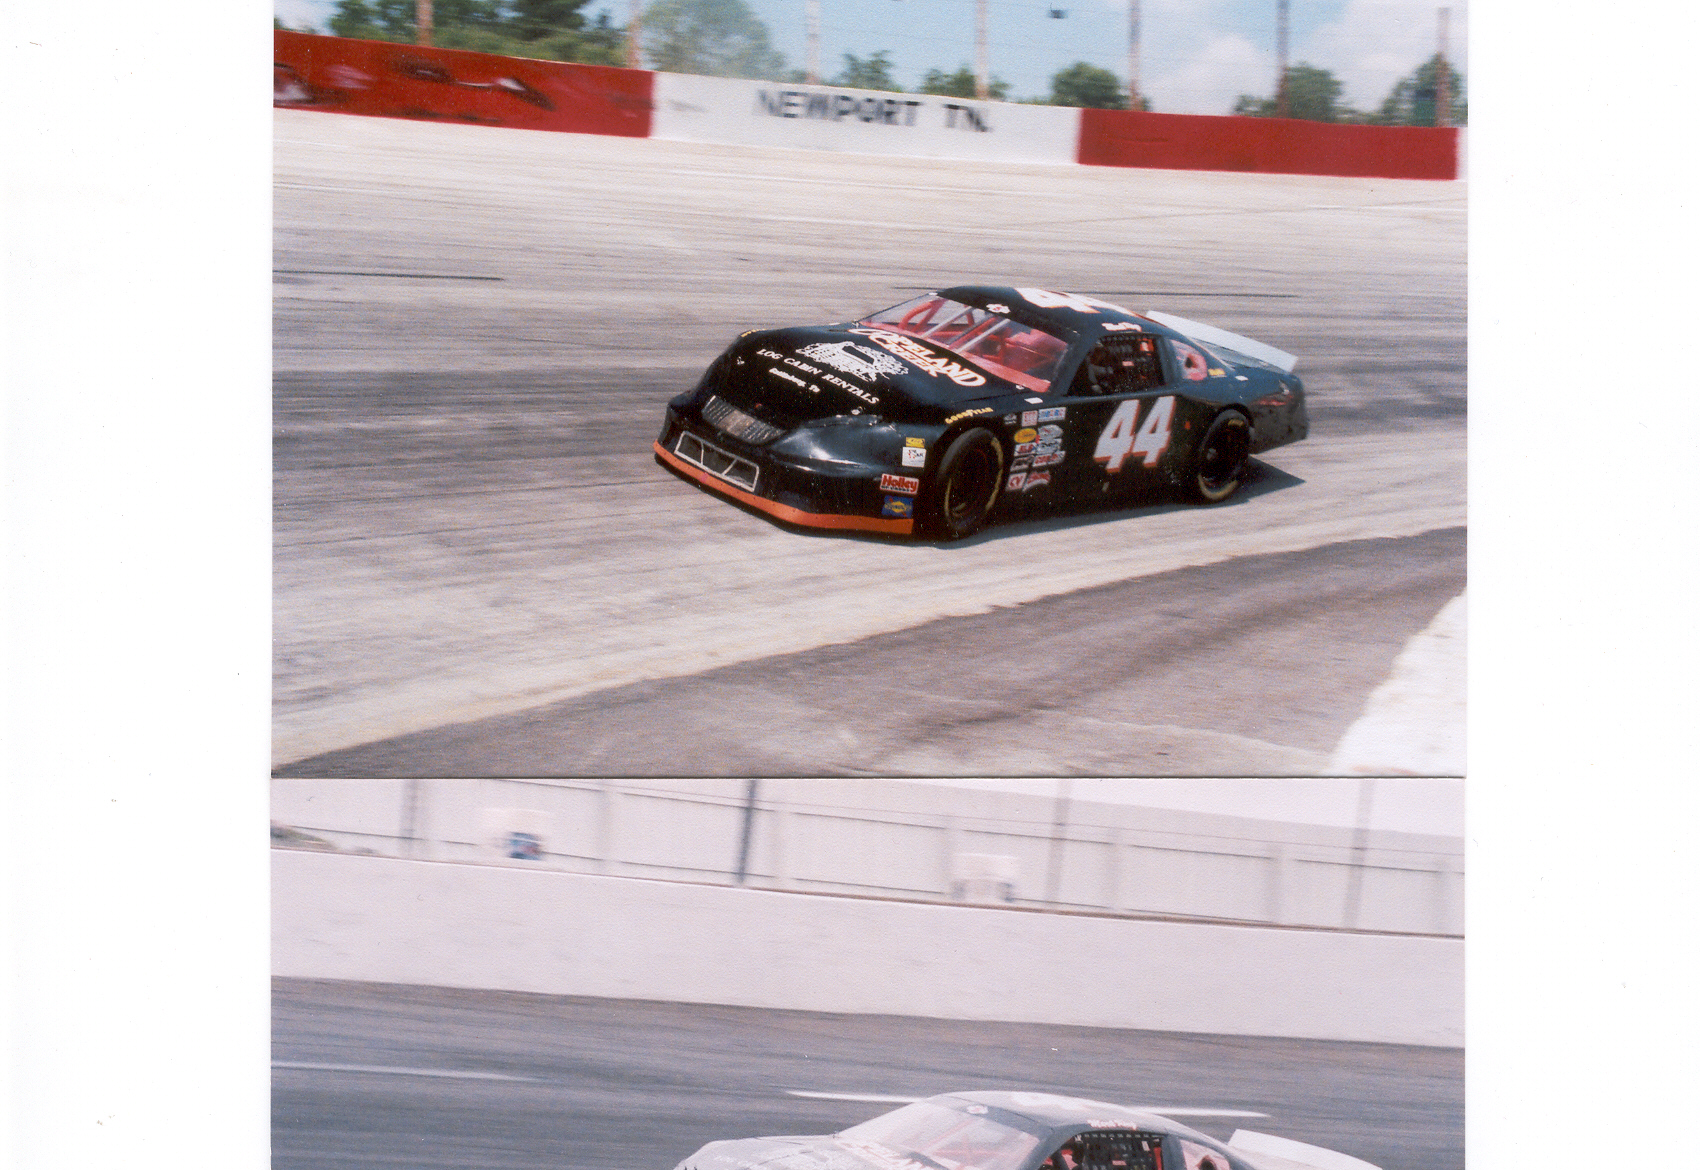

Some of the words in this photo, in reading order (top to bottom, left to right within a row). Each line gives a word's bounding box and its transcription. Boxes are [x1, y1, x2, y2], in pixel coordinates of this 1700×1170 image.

[756, 88, 922, 126] NEWPORT
[756, 348, 783, 360] LOG
[783, 357, 822, 375] CABIN
[822, 373, 880, 405] RENTALS
[848, 328, 986, 387] COPELAND
[868, 333, 938, 378] CREEK
[1093, 395, 1177, 473] 44
[881, 474, 918, 493] Holley
